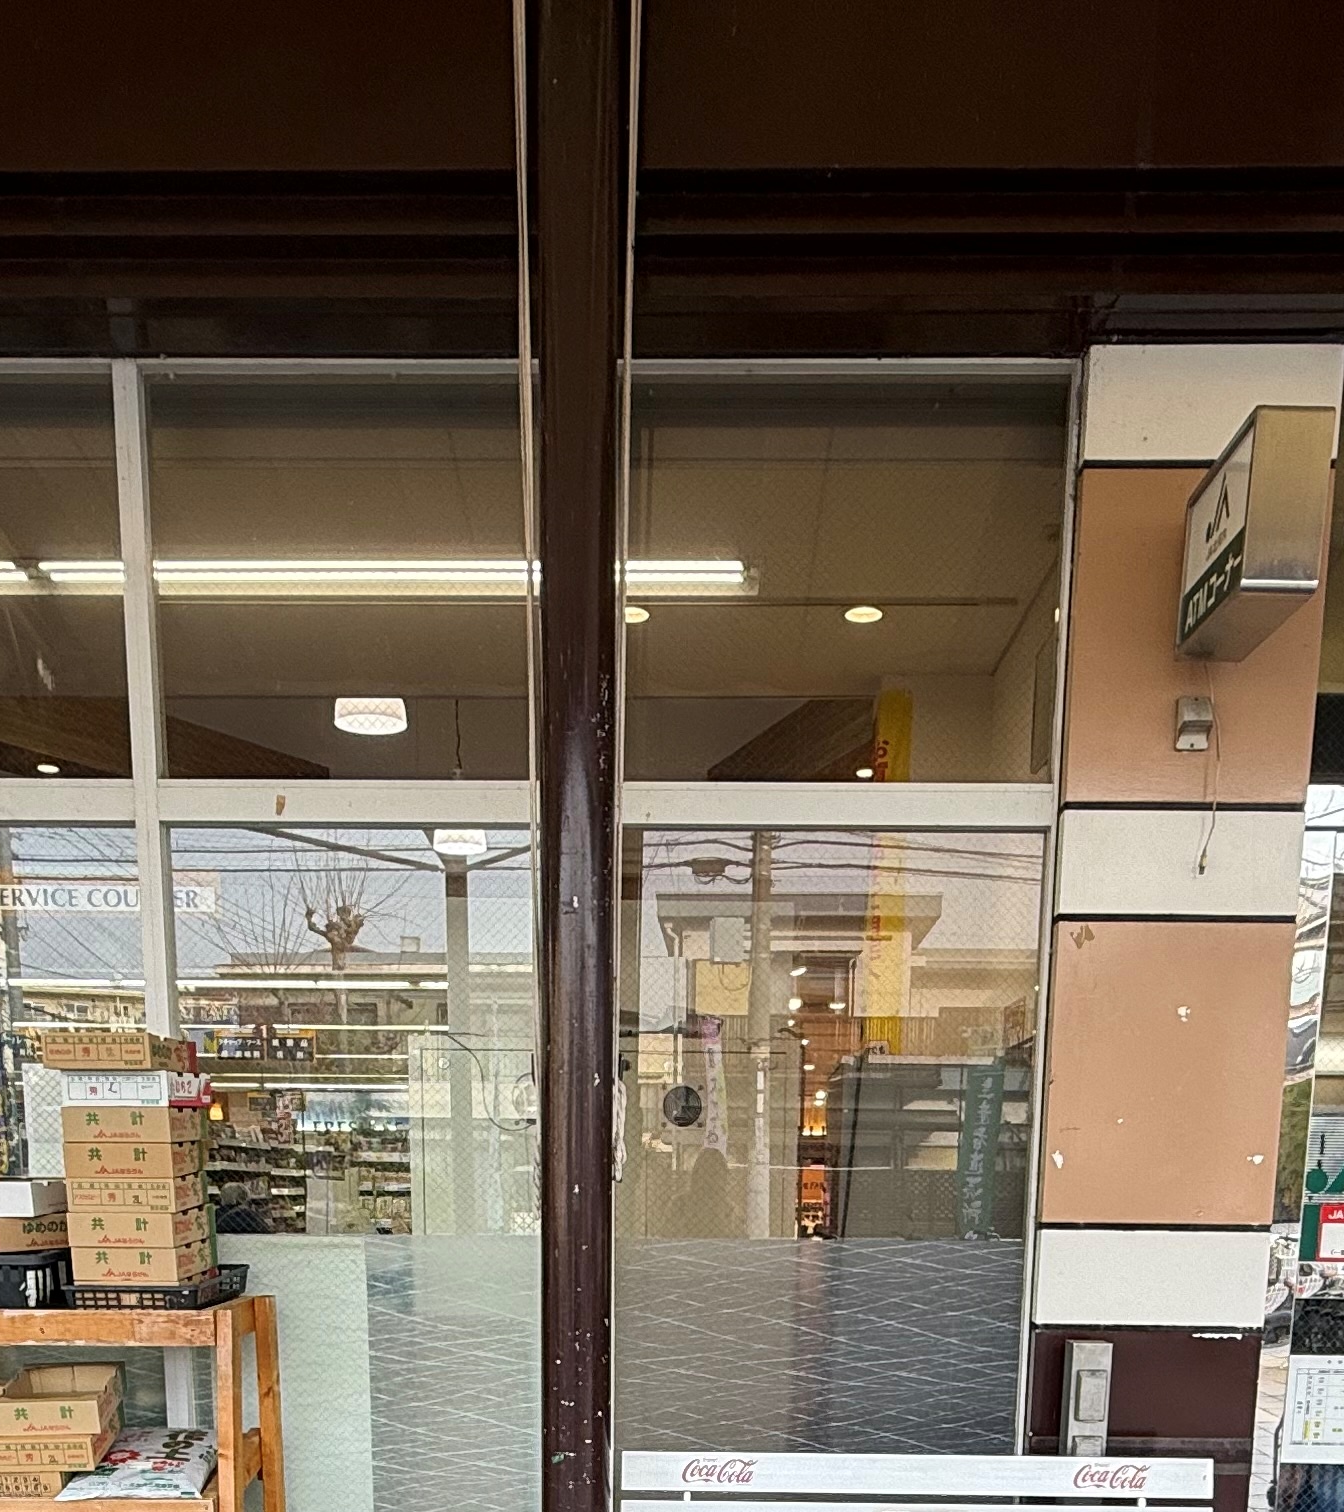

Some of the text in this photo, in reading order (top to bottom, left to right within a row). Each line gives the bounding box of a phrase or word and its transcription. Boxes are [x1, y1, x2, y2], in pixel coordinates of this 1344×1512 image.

[1185, 553, 1242, 634] ATMコーナー
[86, 888, 198, 909] COUER
